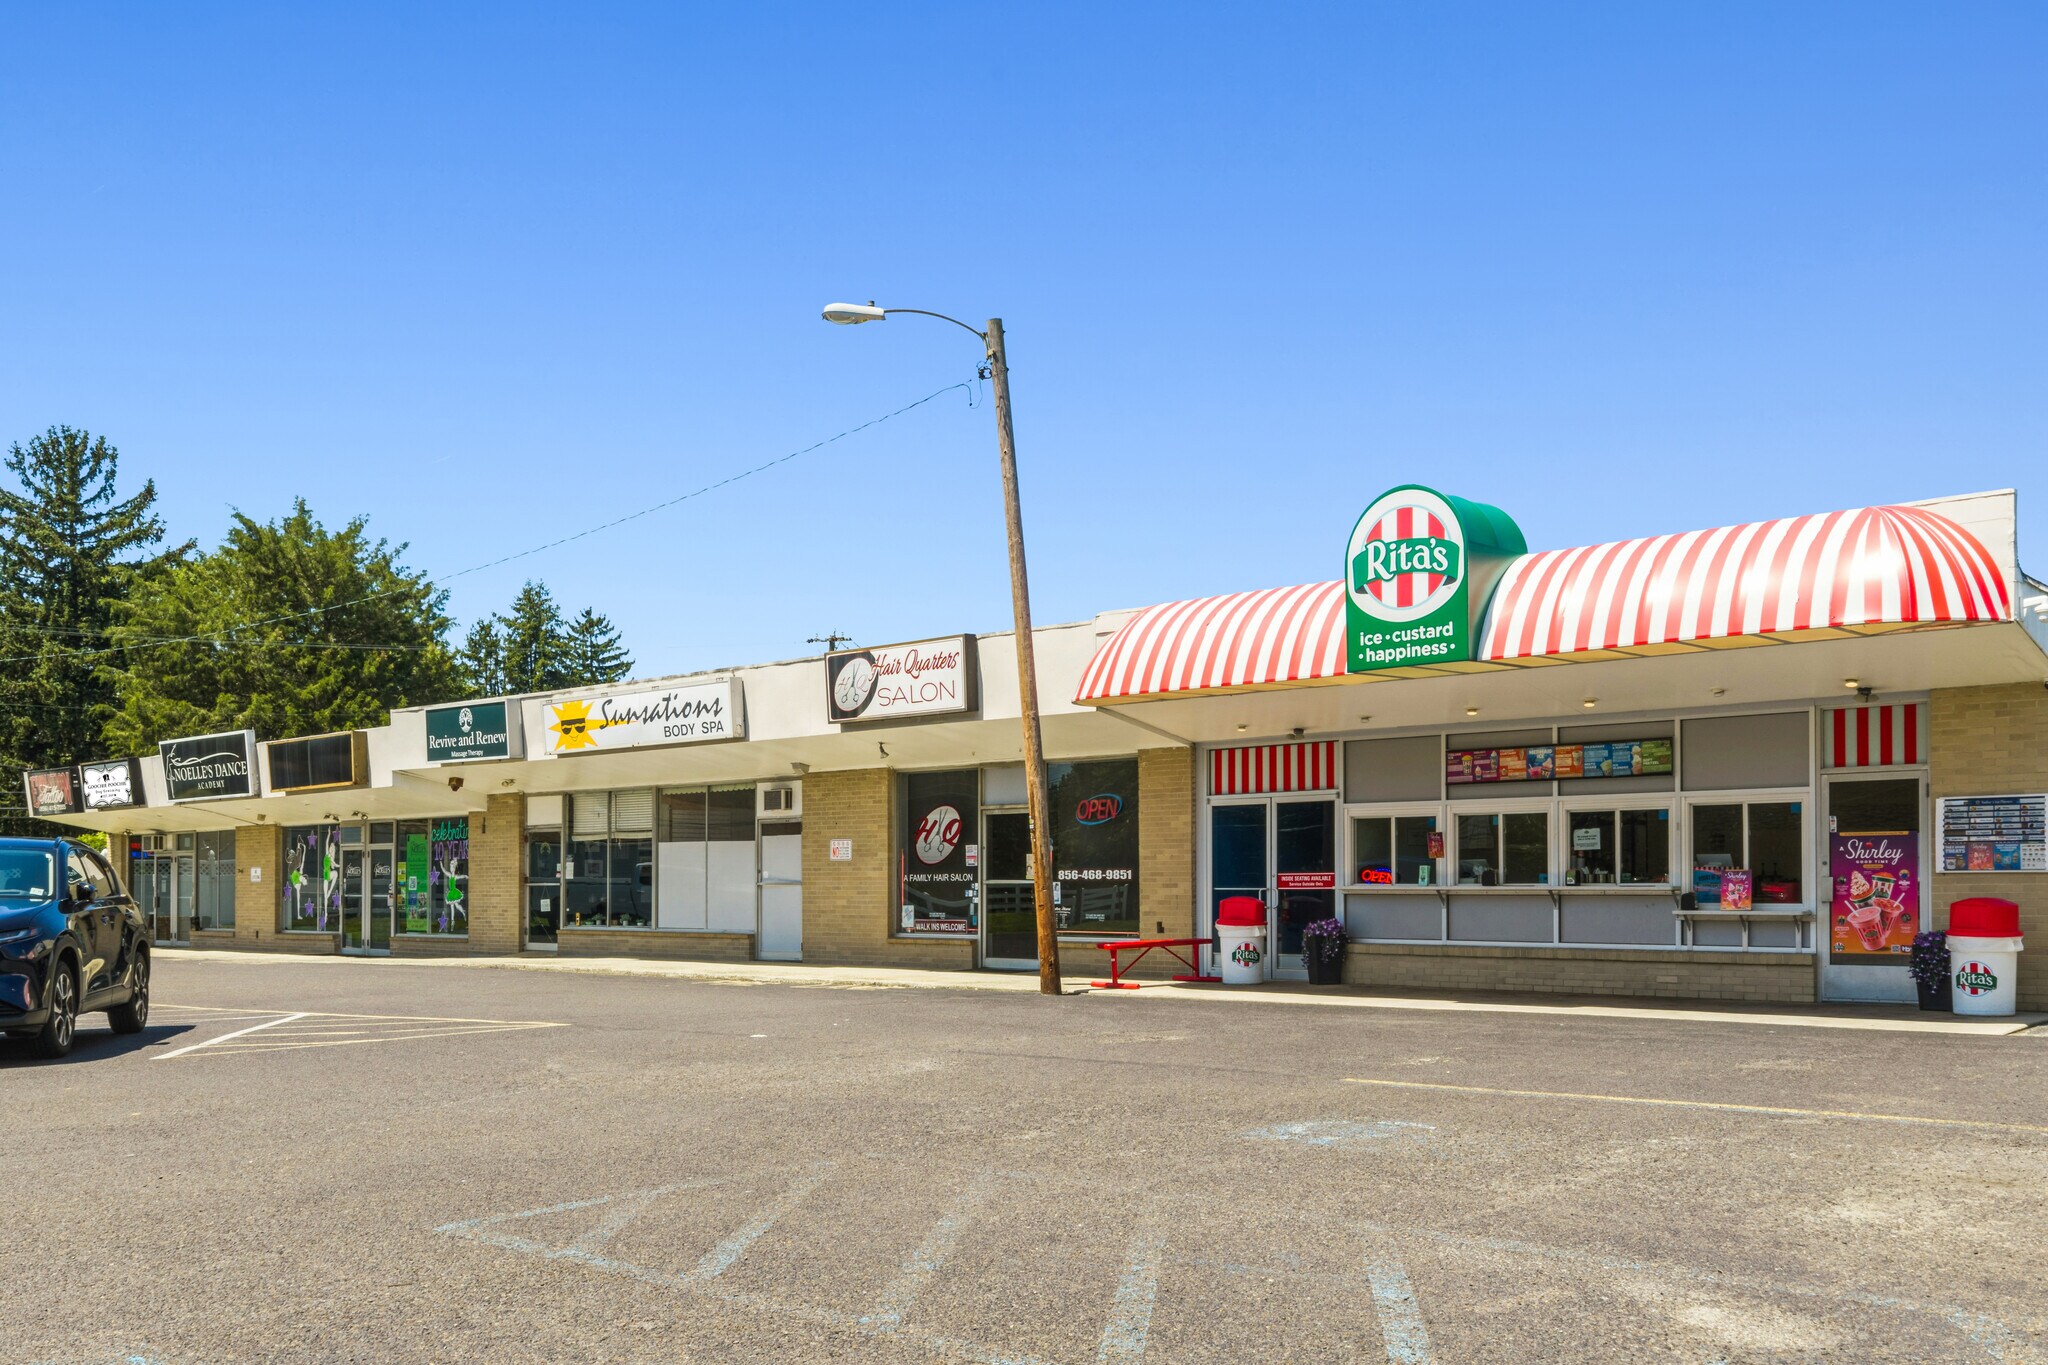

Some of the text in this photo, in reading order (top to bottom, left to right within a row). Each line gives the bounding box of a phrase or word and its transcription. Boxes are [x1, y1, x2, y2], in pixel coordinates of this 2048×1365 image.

[1366, 538, 1448, 581] Rita's
[1360, 621, 1454, 646] ice custard
[1366, 642, 1447, 663] happiness
[868, 649, 960, 682] Hair Quarters
[877, 680, 955, 707] SALON
[600, 693, 723, 730] Sunsations
[664, 720, 724, 738] BODY SPA
[429, 731, 506, 749] Revive and Renew
[468, 749, 484, 757] Therapy
[174, 761, 248, 782] NOELLE'S DANCE
[198, 780, 225, 790] ACADEMY
[1077, 799, 1118, 819] OPEN
[435, 841, 445, 860] 10
[1845, 839, 1904, 866] Shirley
[950, 873, 974, 881] SALON
[1058, 869, 1132, 880] 856-468-9851
[916, 923, 966, 931] WALK INS WELCOME
[1236, 950, 1258, 960] Rita's
[1960, 971, 1993, 986] Rita's
